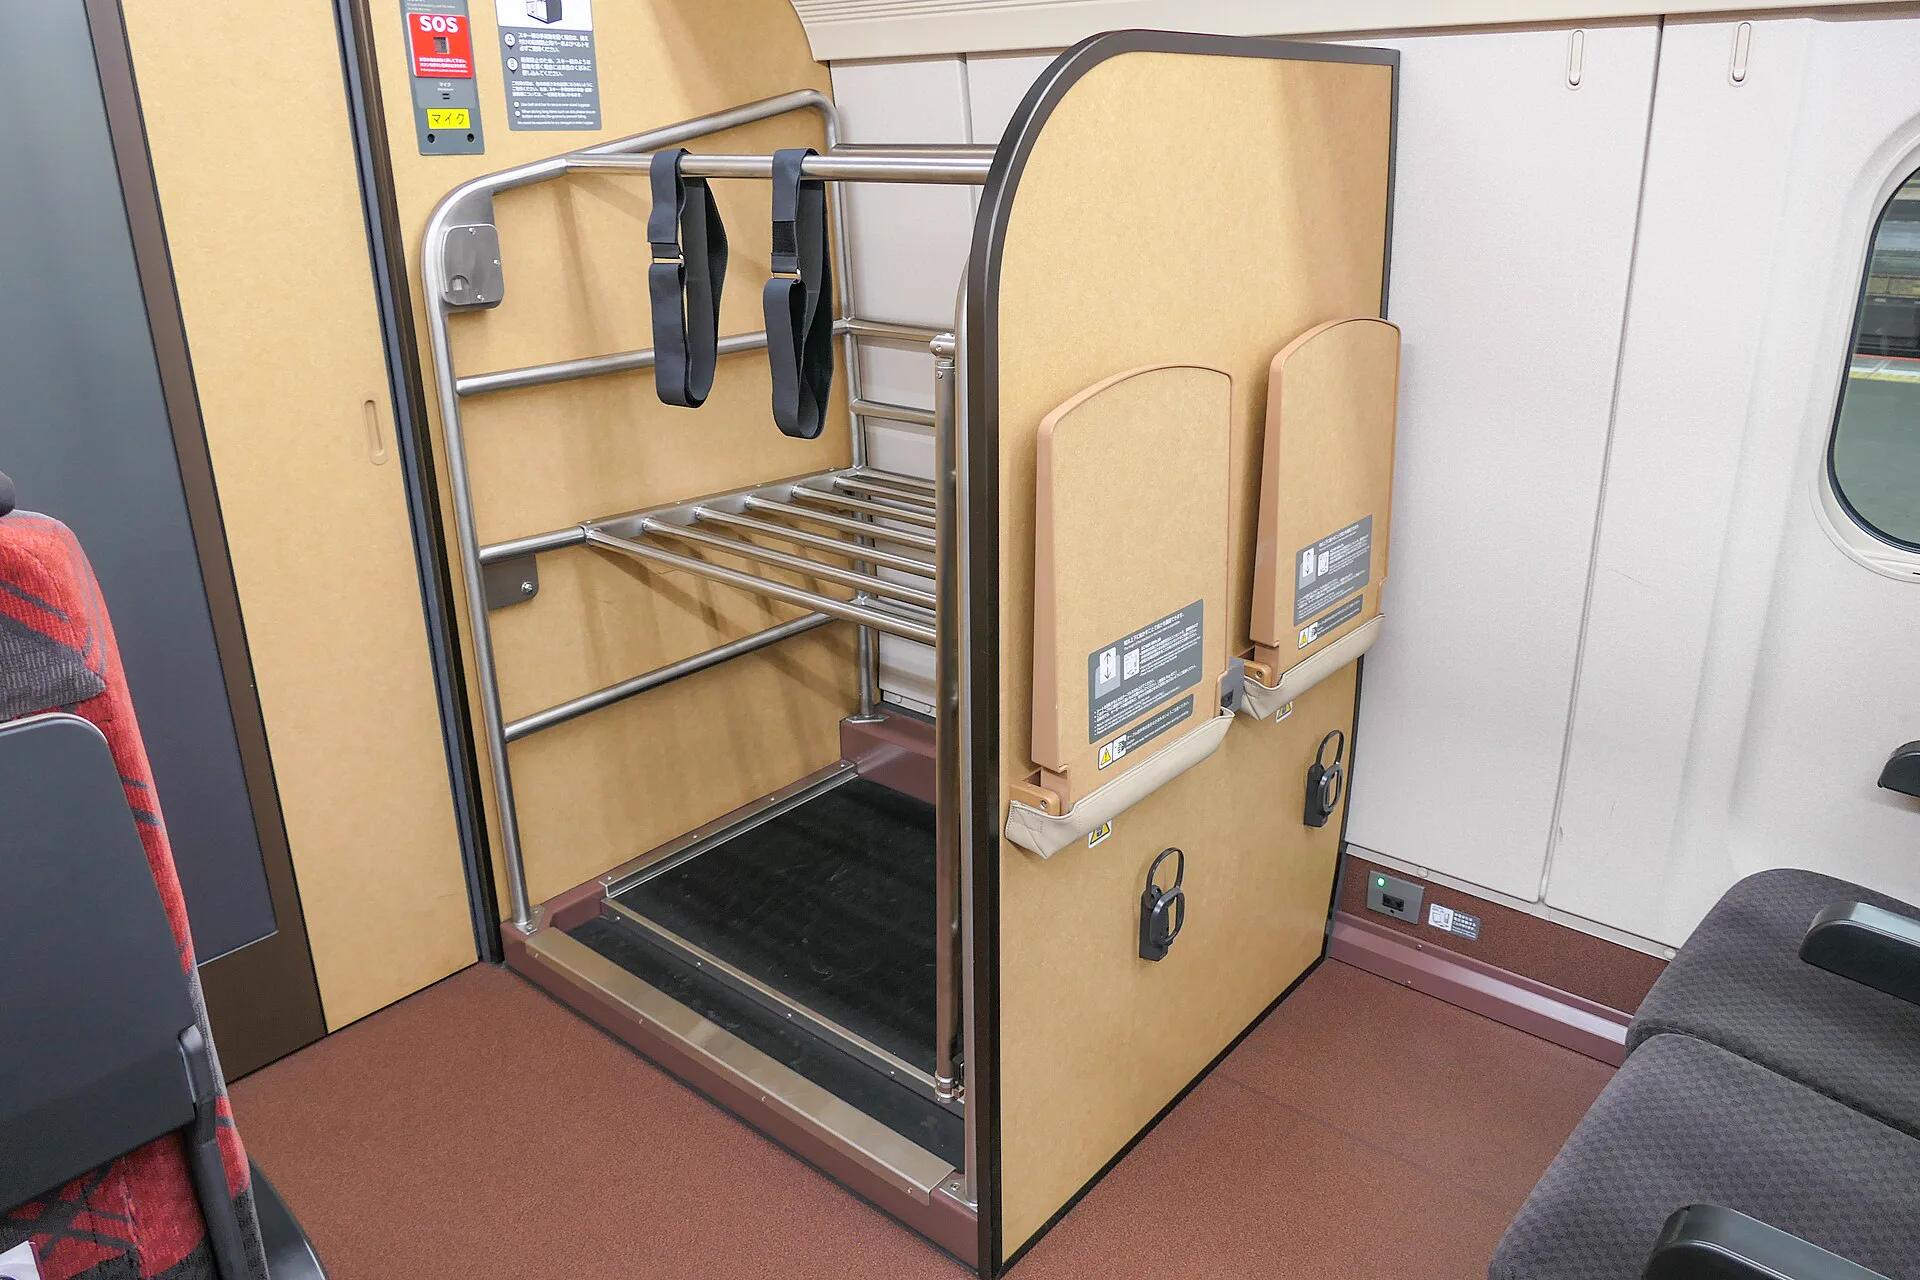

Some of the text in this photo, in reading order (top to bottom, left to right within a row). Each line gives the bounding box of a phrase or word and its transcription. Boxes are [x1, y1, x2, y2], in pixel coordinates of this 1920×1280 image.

[419, 15, 459, 33] SOS
[431, 113, 465, 125] マイク
